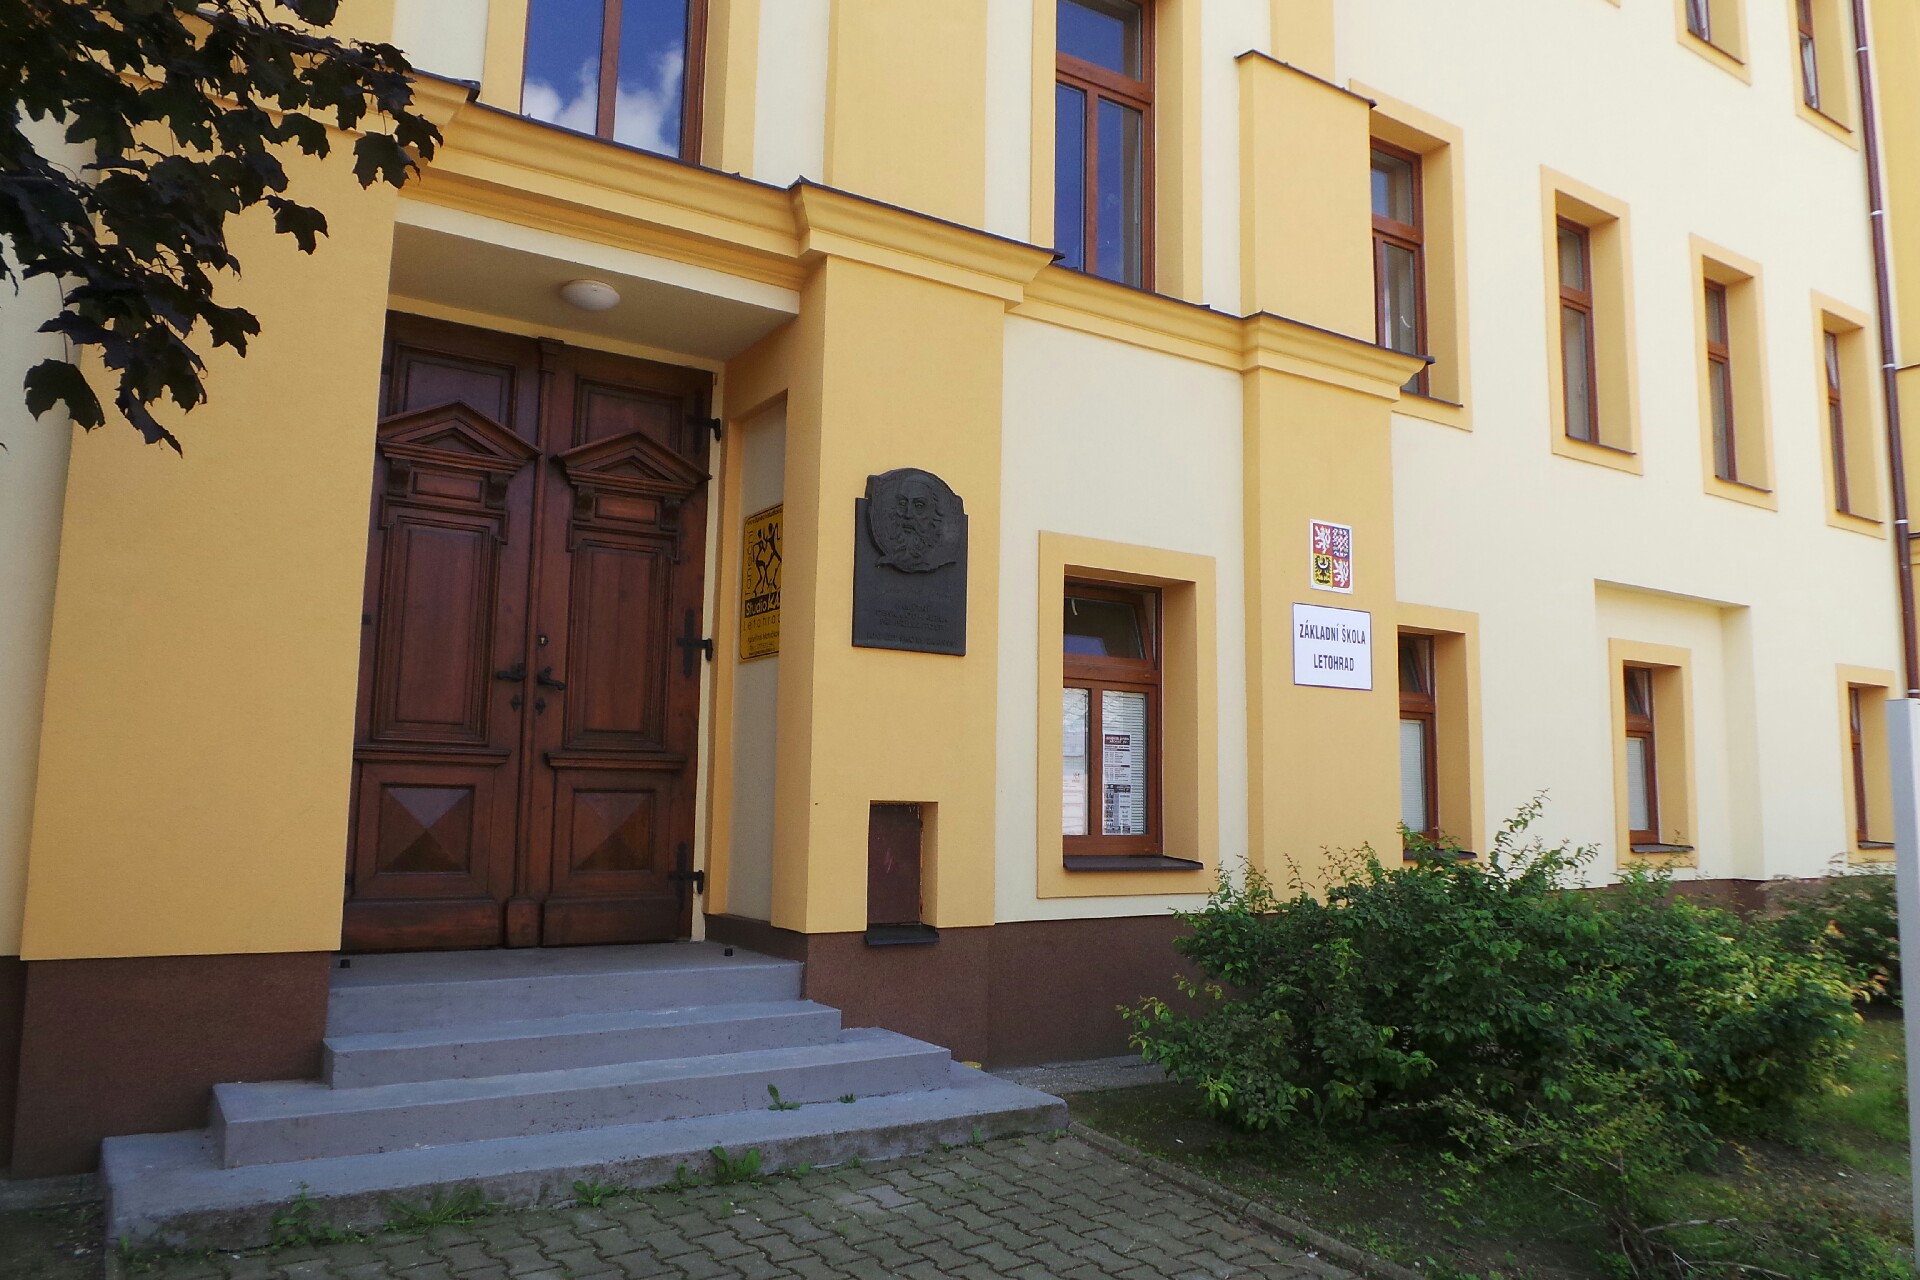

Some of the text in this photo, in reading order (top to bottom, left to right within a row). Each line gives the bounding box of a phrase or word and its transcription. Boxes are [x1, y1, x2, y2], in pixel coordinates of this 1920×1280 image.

[746, 599, 768, 616] Studio
[1299, 620, 1366, 645] ZÁKLADNÍ ŠKOLA
[1313, 654, 1355, 672] LETOHRAD
